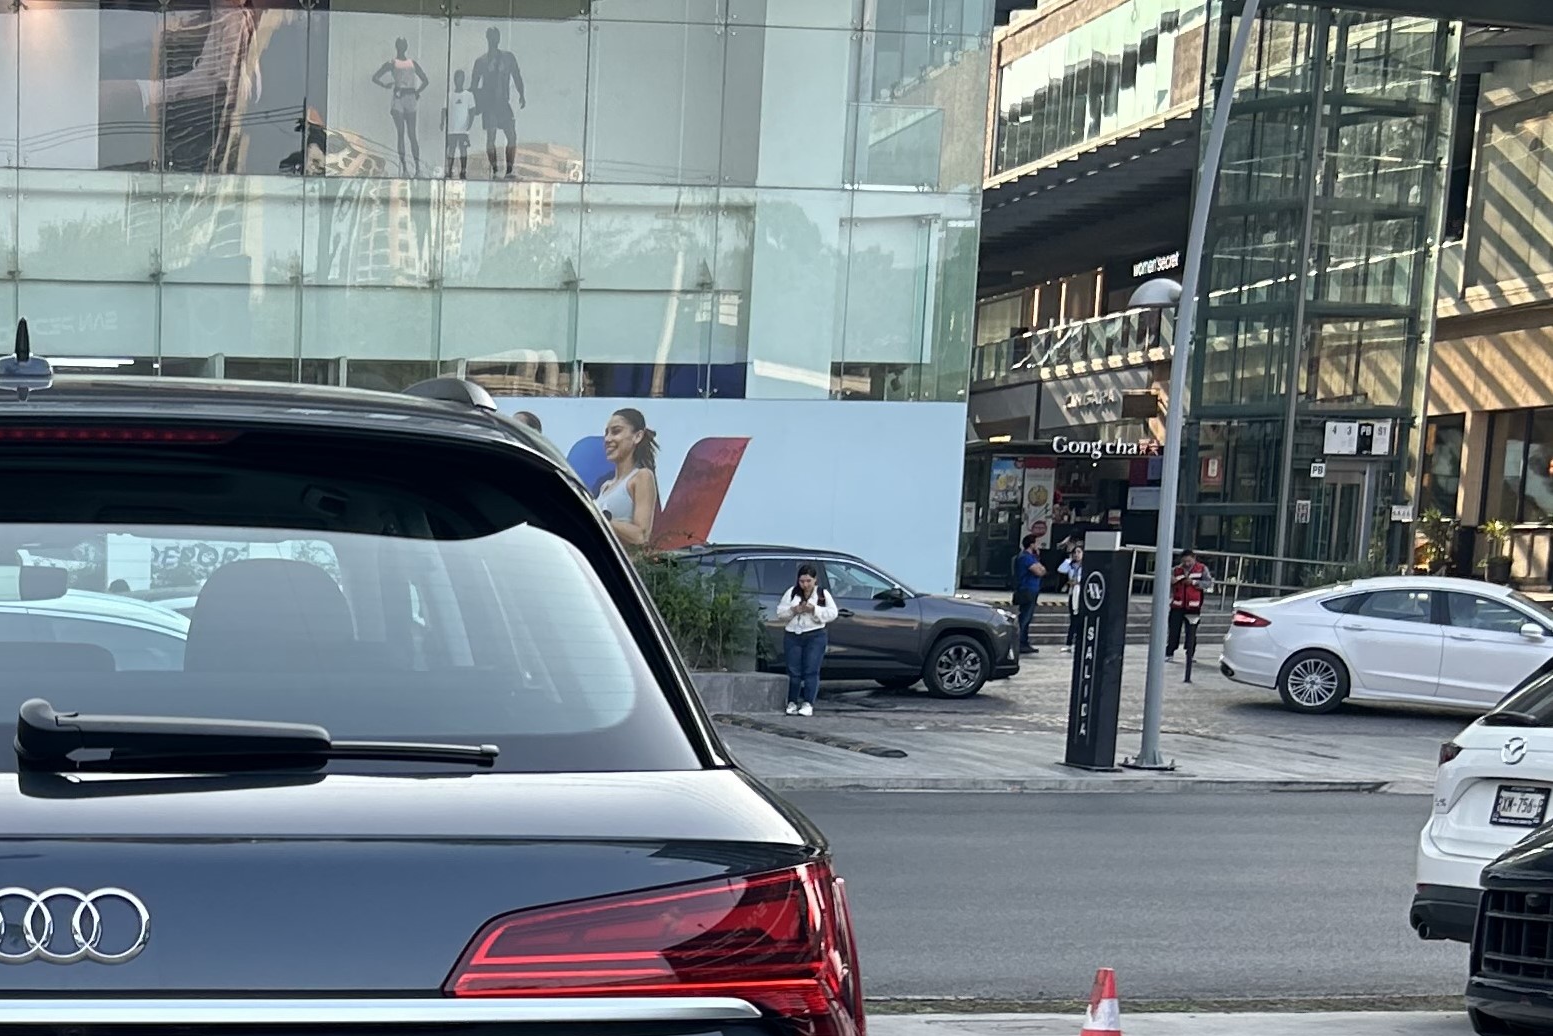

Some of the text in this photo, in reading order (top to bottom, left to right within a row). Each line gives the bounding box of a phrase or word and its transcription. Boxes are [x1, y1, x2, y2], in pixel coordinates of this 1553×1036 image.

[1052, 436, 1138, 459] Gong cha
[1078, 626, 1095, 737] SALIDA
